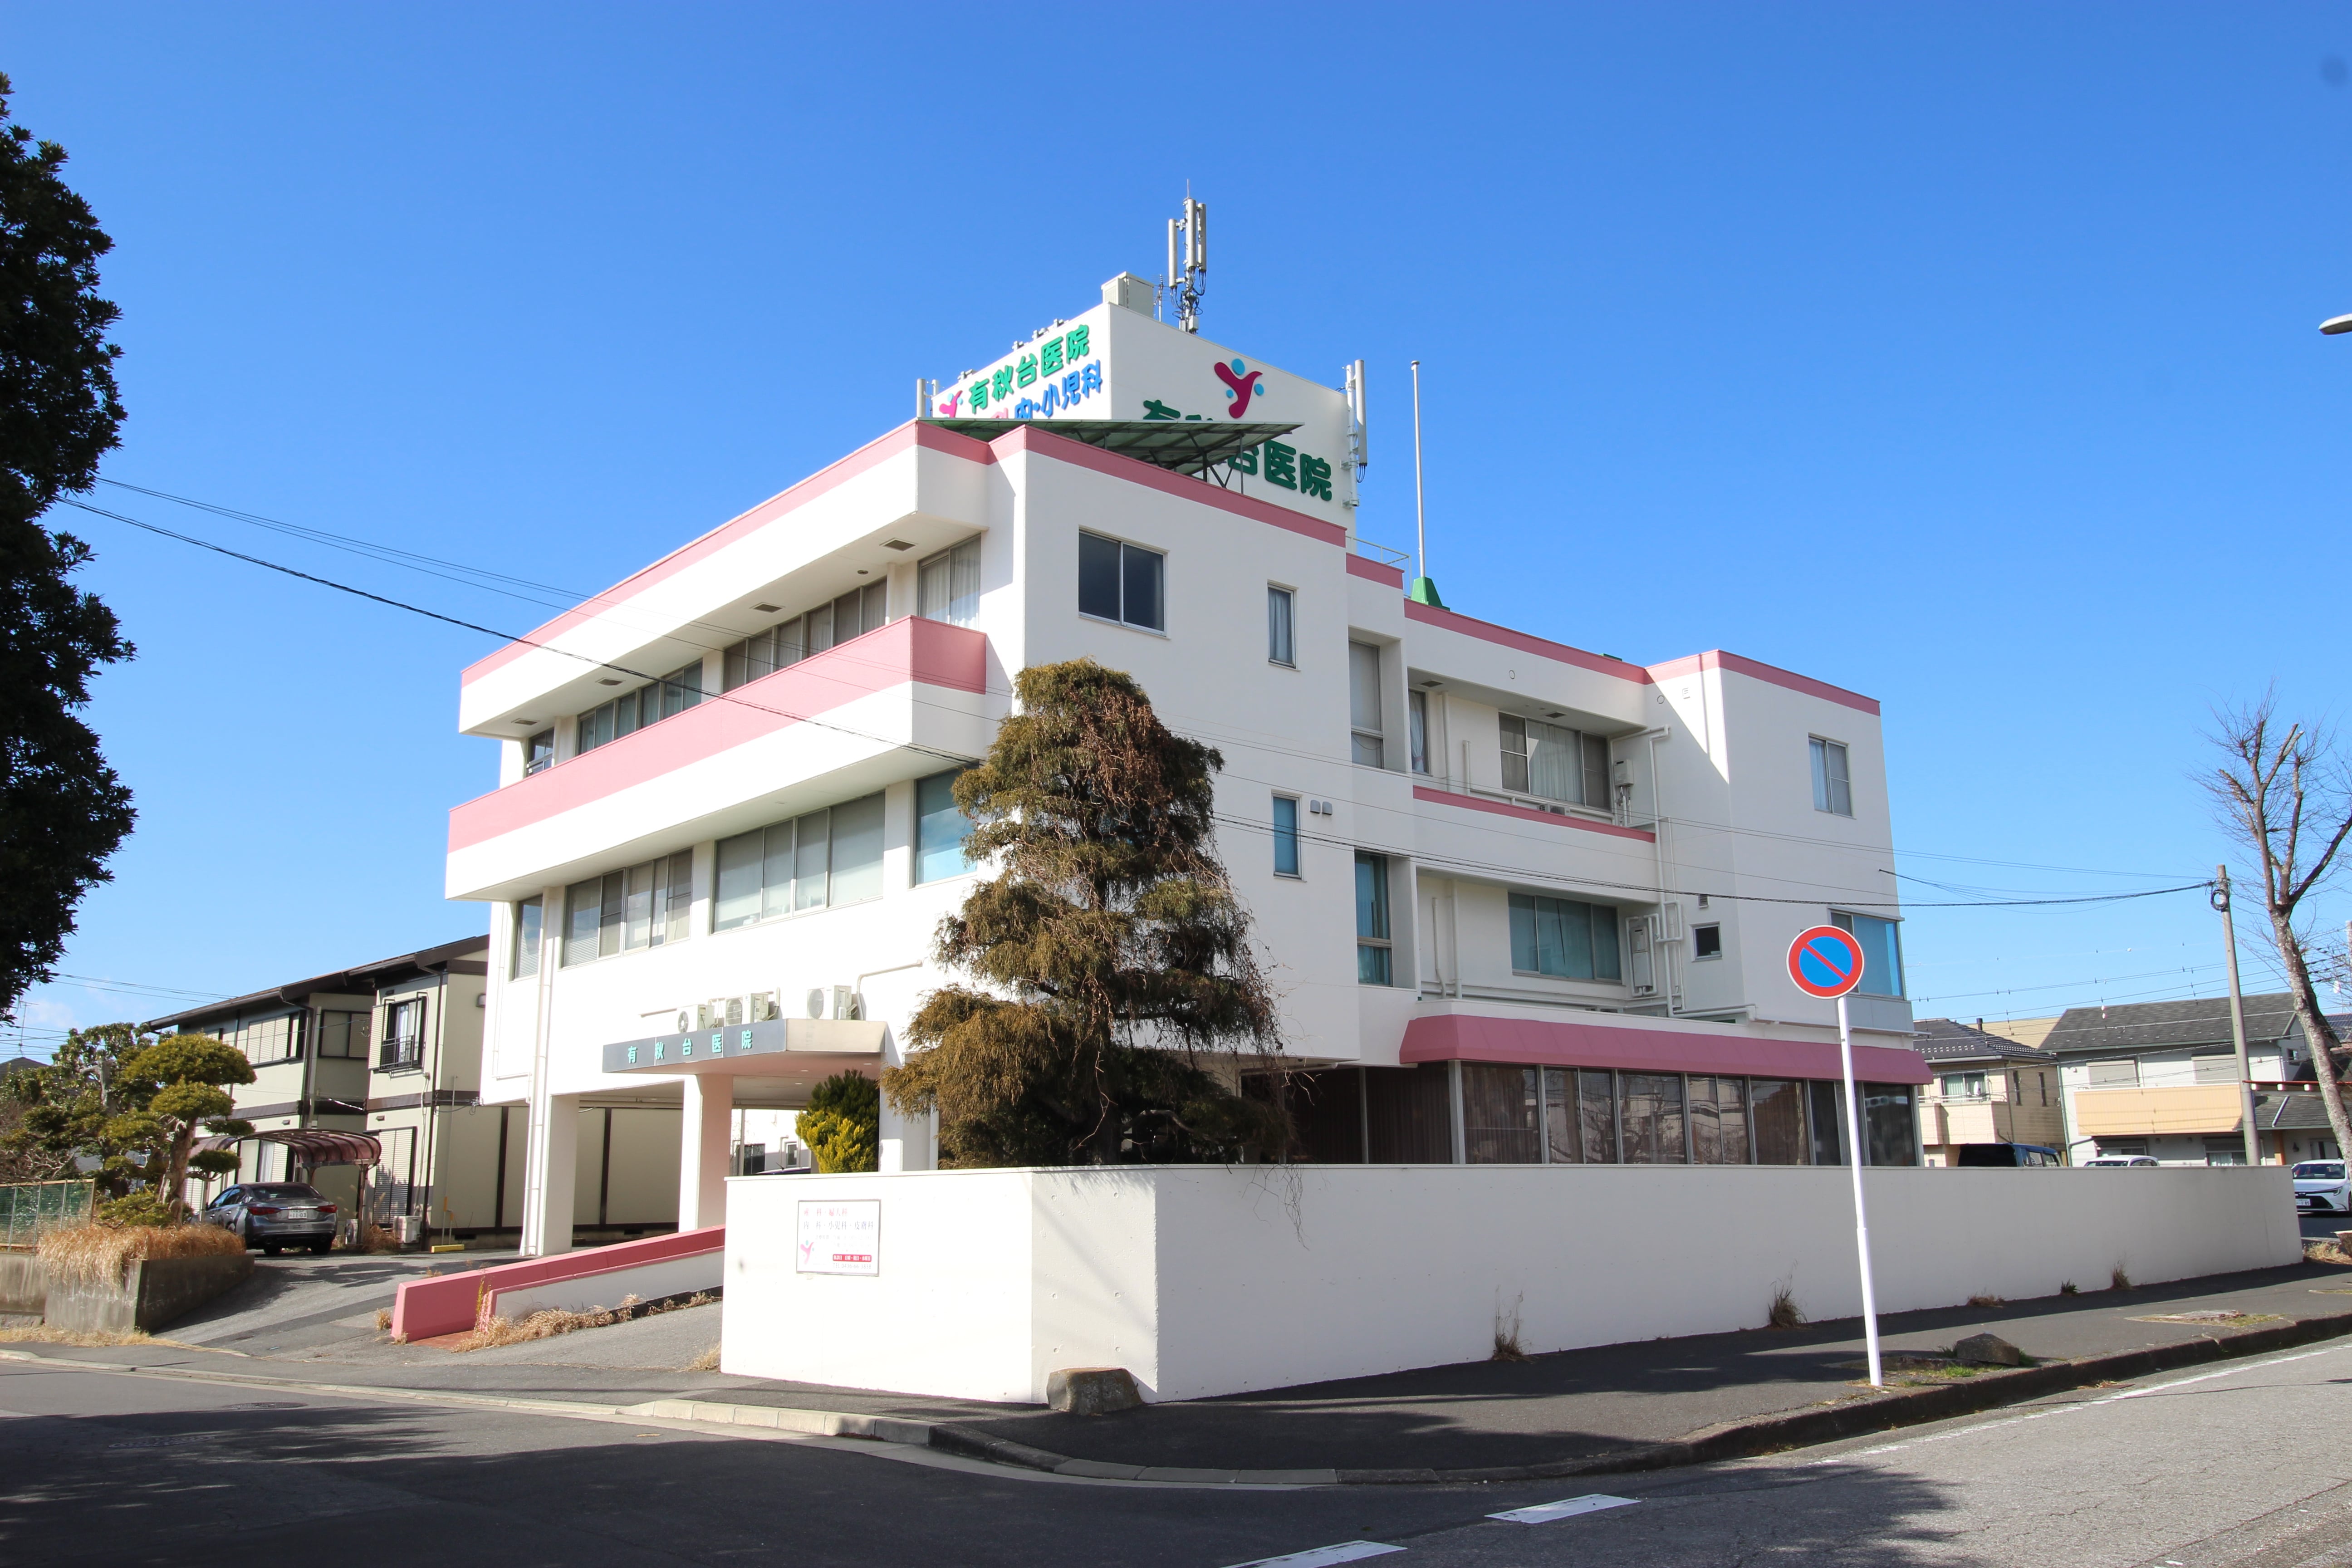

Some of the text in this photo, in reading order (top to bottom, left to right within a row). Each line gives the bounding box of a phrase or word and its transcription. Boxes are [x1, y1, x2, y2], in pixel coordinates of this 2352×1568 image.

[969, 324, 1089, 414] 有秋台医院
[627, 1029, 753, 1064] 有秋台医院
